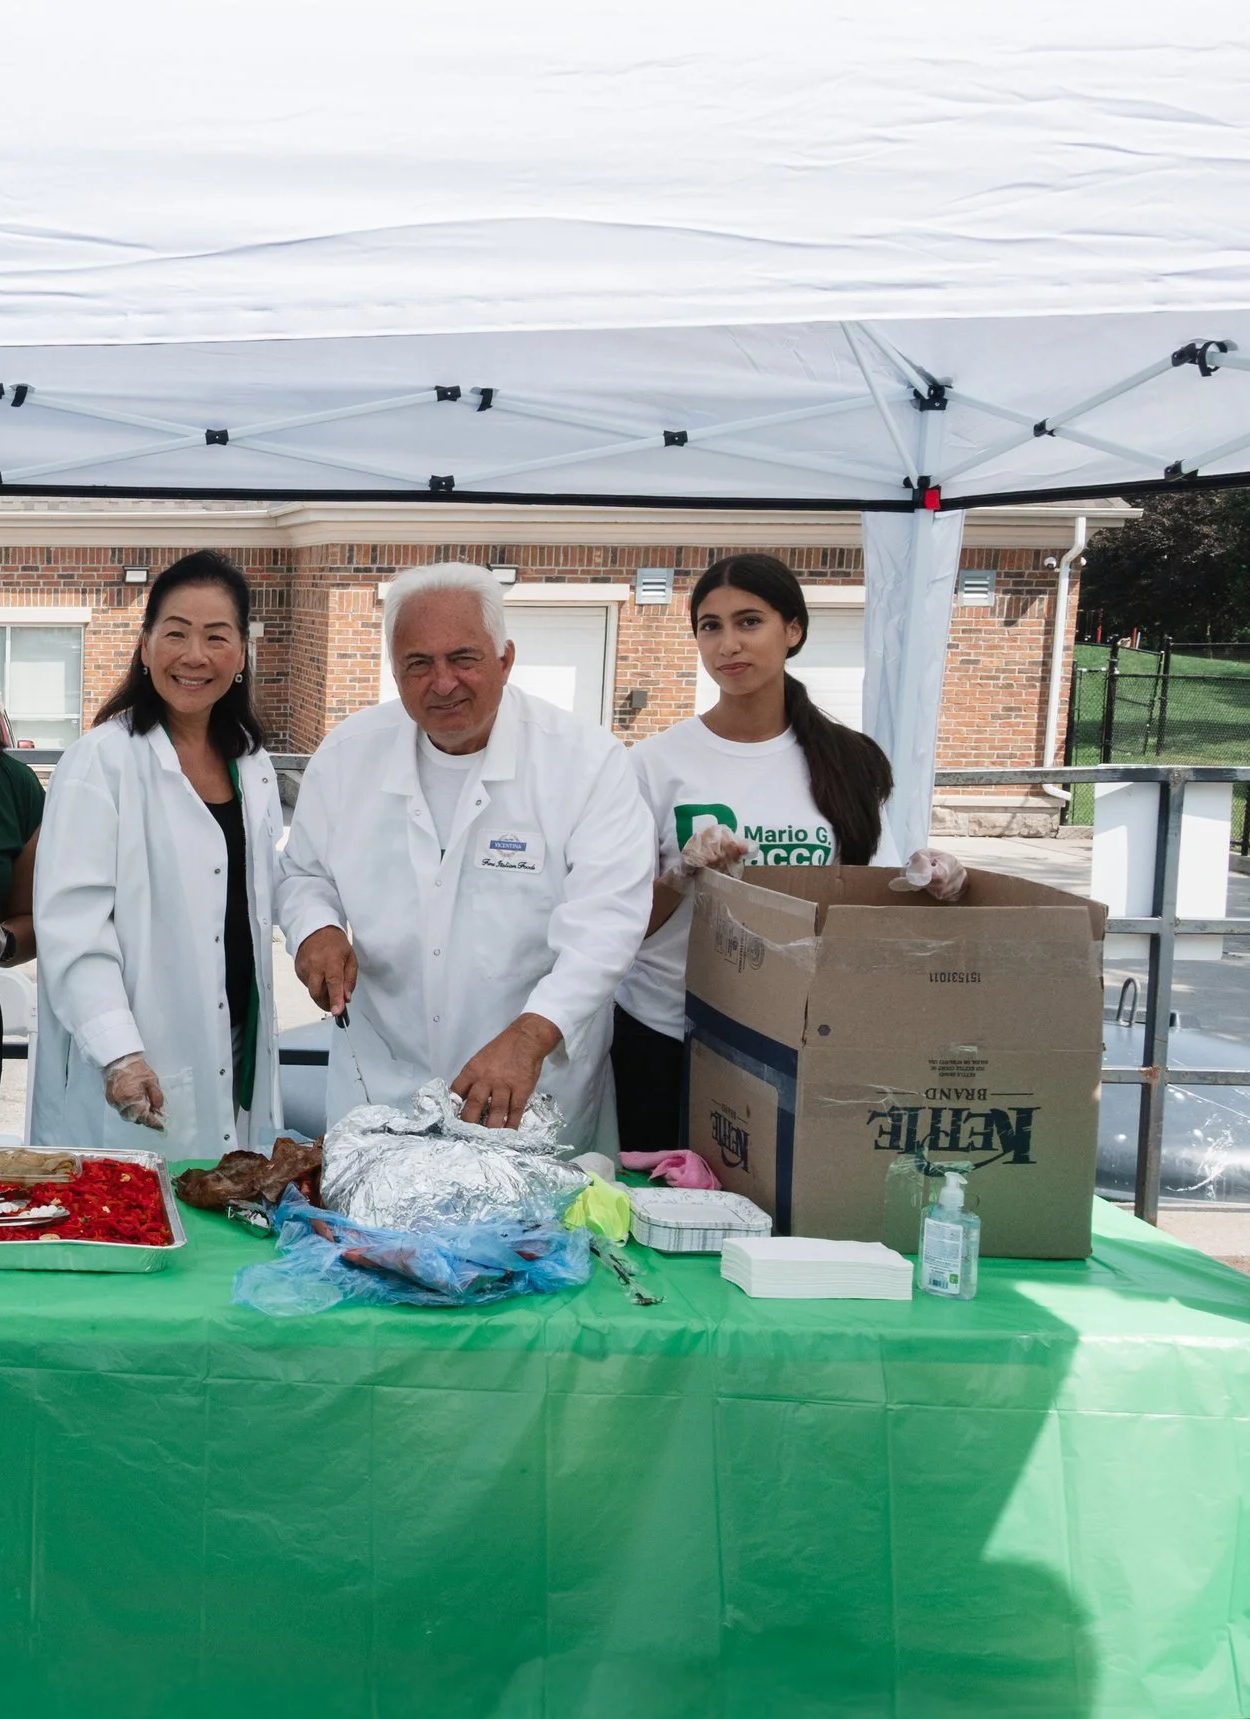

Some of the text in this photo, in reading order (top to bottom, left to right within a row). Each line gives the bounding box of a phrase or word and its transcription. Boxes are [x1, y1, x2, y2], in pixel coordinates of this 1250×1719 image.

[744, 825, 831, 846] Mario G.
[929, 972, 981, 983] 151531011
[924, 1088, 988, 1101] BRAND
